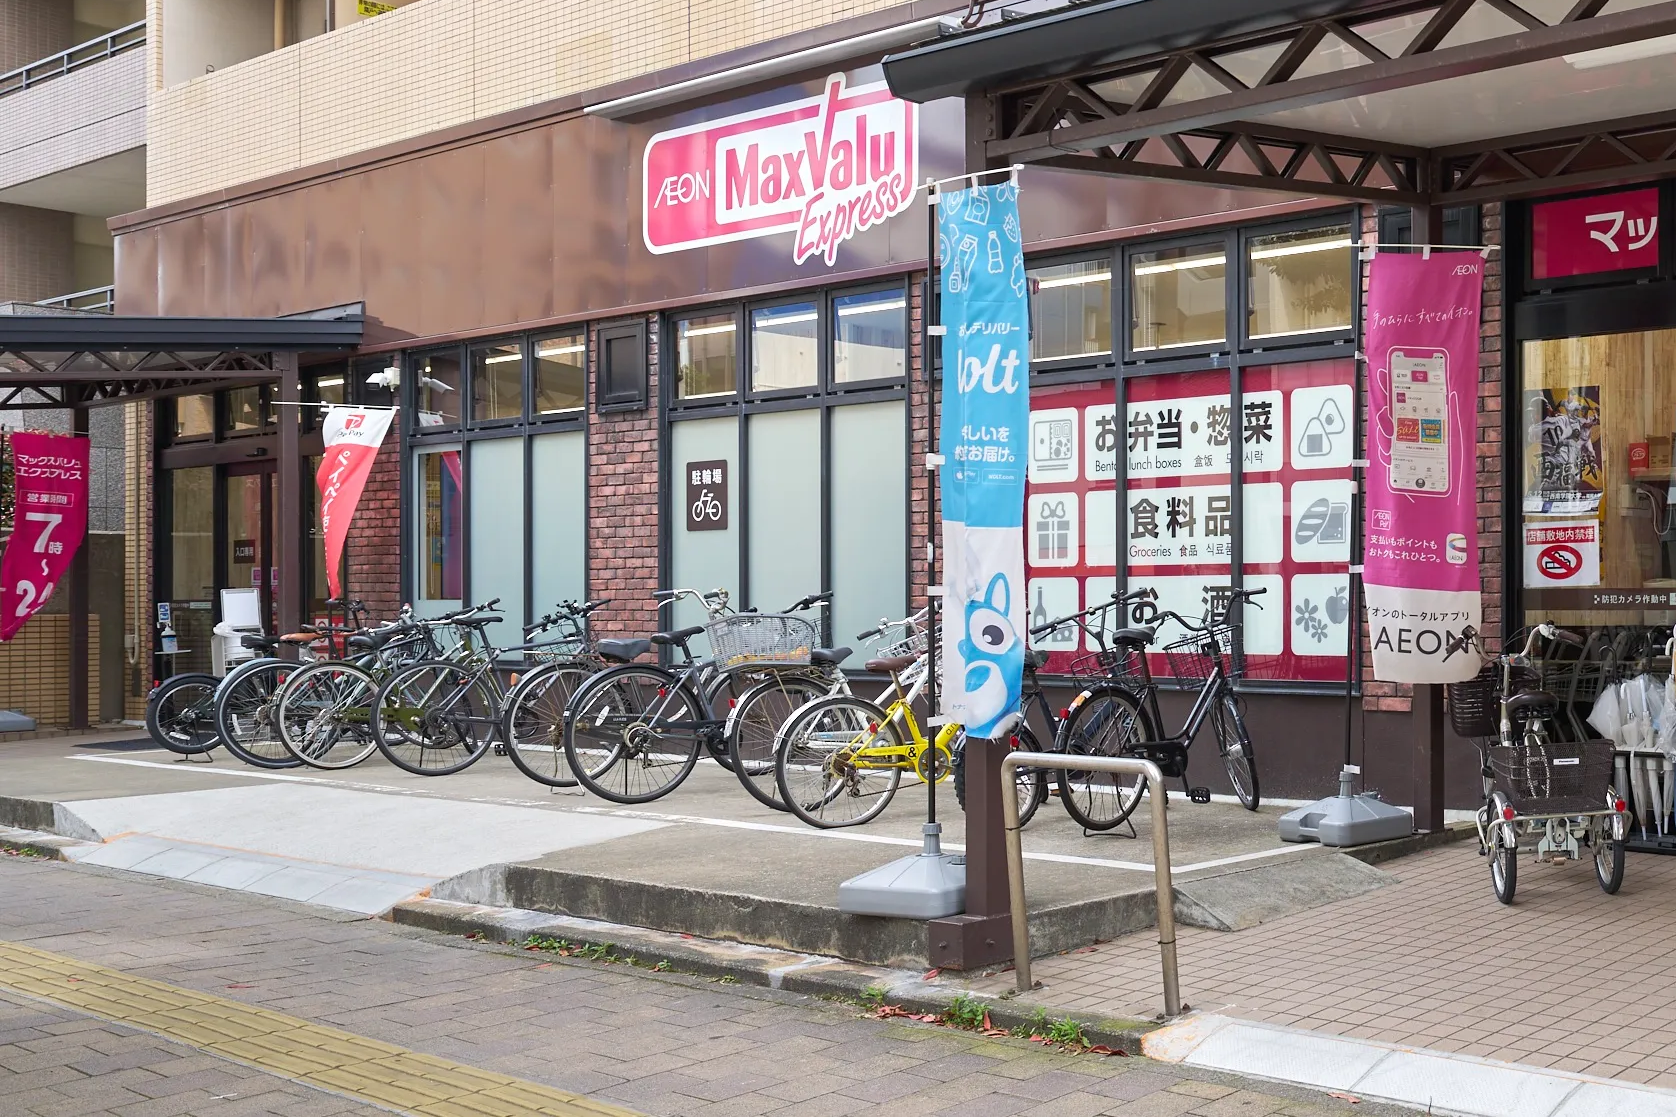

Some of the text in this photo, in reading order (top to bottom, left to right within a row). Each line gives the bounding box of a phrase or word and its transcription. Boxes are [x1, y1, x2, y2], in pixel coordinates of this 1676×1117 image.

[725, 80, 896, 211] MaxValu
[796, 172, 902, 262] Express
[1095, 400, 1273, 453] お弁当・惣菜
[1128, 457, 1152, 471] lunch
[1155, 455, 1182, 469] boxes
[16, 466, 82, 481] エクスプレス
[691, 468, 722, 485] 駐輪場
[27, 493, 67, 505] 営業時間
[1129, 495, 1232, 540] 食料品
[1369, 534, 1438, 550] 支払いもポイントも
[1527, 526, 1595, 543] 店舗敷地内禁煙
[1129, 544, 1172, 558] Groceries
[1368, 547, 1441, 563] おトクもこれひとつ。
[1601, 594, 1667, 604] 防犯カメラ作動中
[907, 746, 917, 758] &
